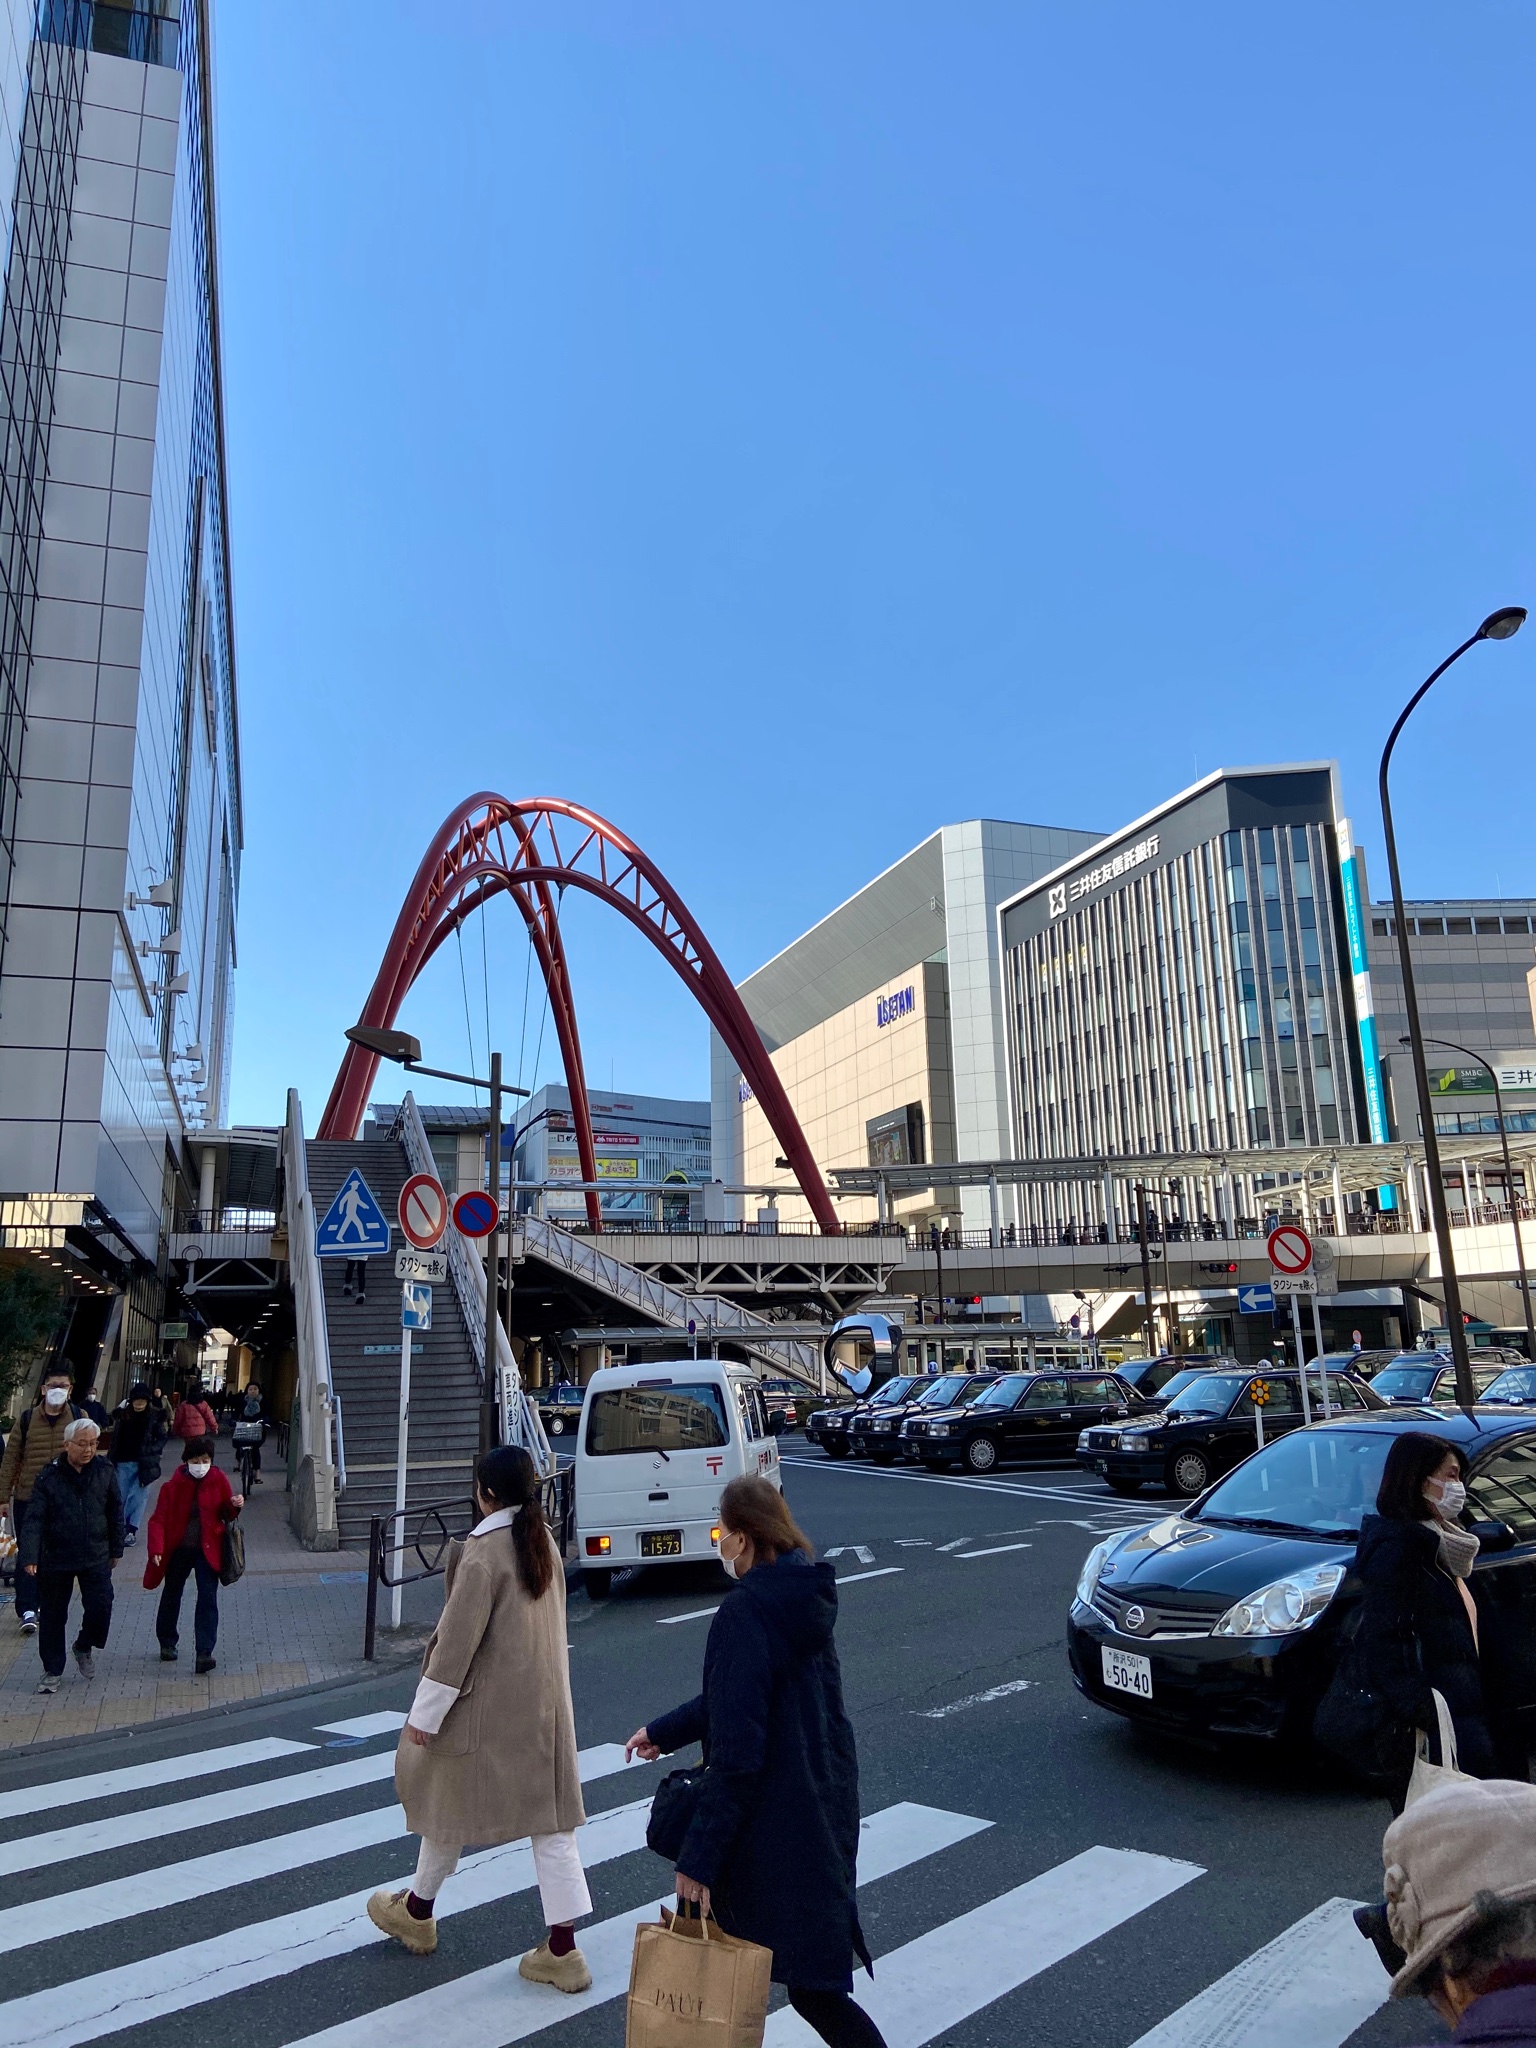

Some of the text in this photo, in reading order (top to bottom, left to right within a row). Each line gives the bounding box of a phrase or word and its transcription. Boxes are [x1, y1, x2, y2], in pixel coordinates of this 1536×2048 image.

[1069, 834, 1160, 902] 三井住友信託銀行
[1460, 1069, 1483, 1077] SMBC
[1501, 1069, 1536, 1084] 三井
[400, 1257, 444, 1276] タクシーを除く
[1273, 1280, 1315, 1291] タクシーを除く
[511, 1372, 521, 1446] タクシー
[651, 1541, 680, 1555] 15-73
[1127, 1655, 1139, 1669] 501
[1112, 1665, 1149, 1694] 50-40
